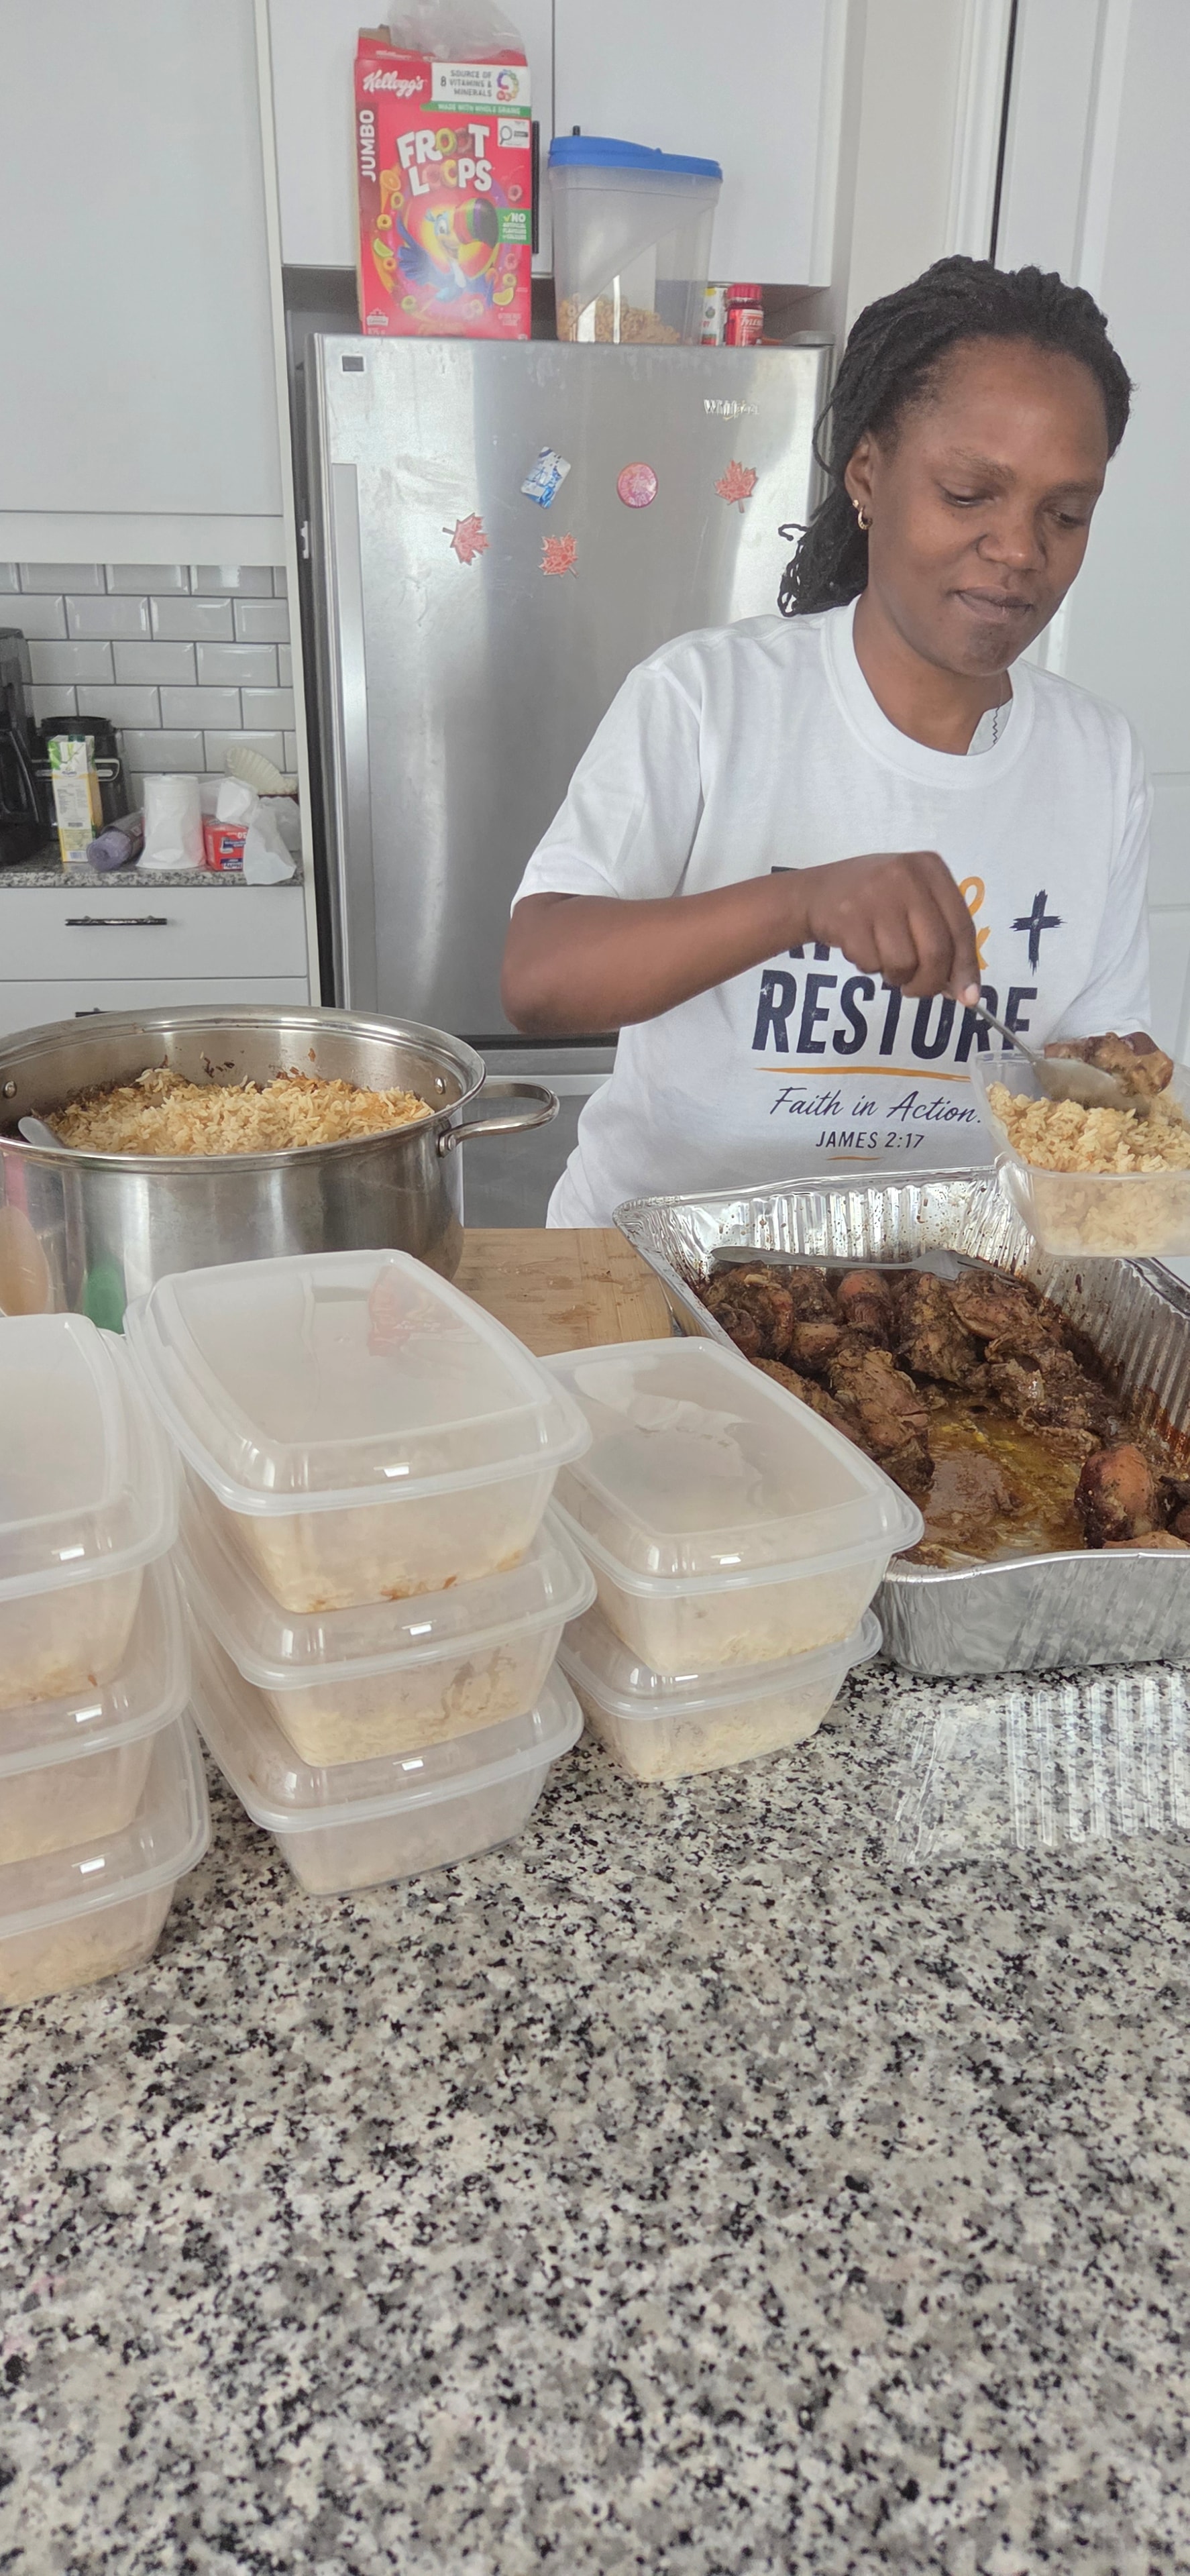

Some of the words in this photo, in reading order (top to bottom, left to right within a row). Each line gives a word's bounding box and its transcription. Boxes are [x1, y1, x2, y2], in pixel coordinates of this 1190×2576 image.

[363, 69, 425, 99] Kellogg's
[440, 76, 447, 87] 8
[449, 78, 484, 88] VITAMINS
[450, 70, 480, 78] SOURCE
[453, 89, 492, 97] MINERALS
[457, 104, 474, 113] WITH
[359, 109, 376, 183] JUMBO
[396, 123, 490, 169] FROOT
[409, 158, 492, 197] LOOPS
[510, 213, 526, 222] NO
[751, 969, 1038, 1063] RESTORE
[769, 1087, 844, 1116] Faith
[851, 1095, 878, 1116] in
[887, 1091, 981, 1124] Action.
[816, 1131, 878, 1148] JAMES
[884, 1132, 925, 1149] 2:17
